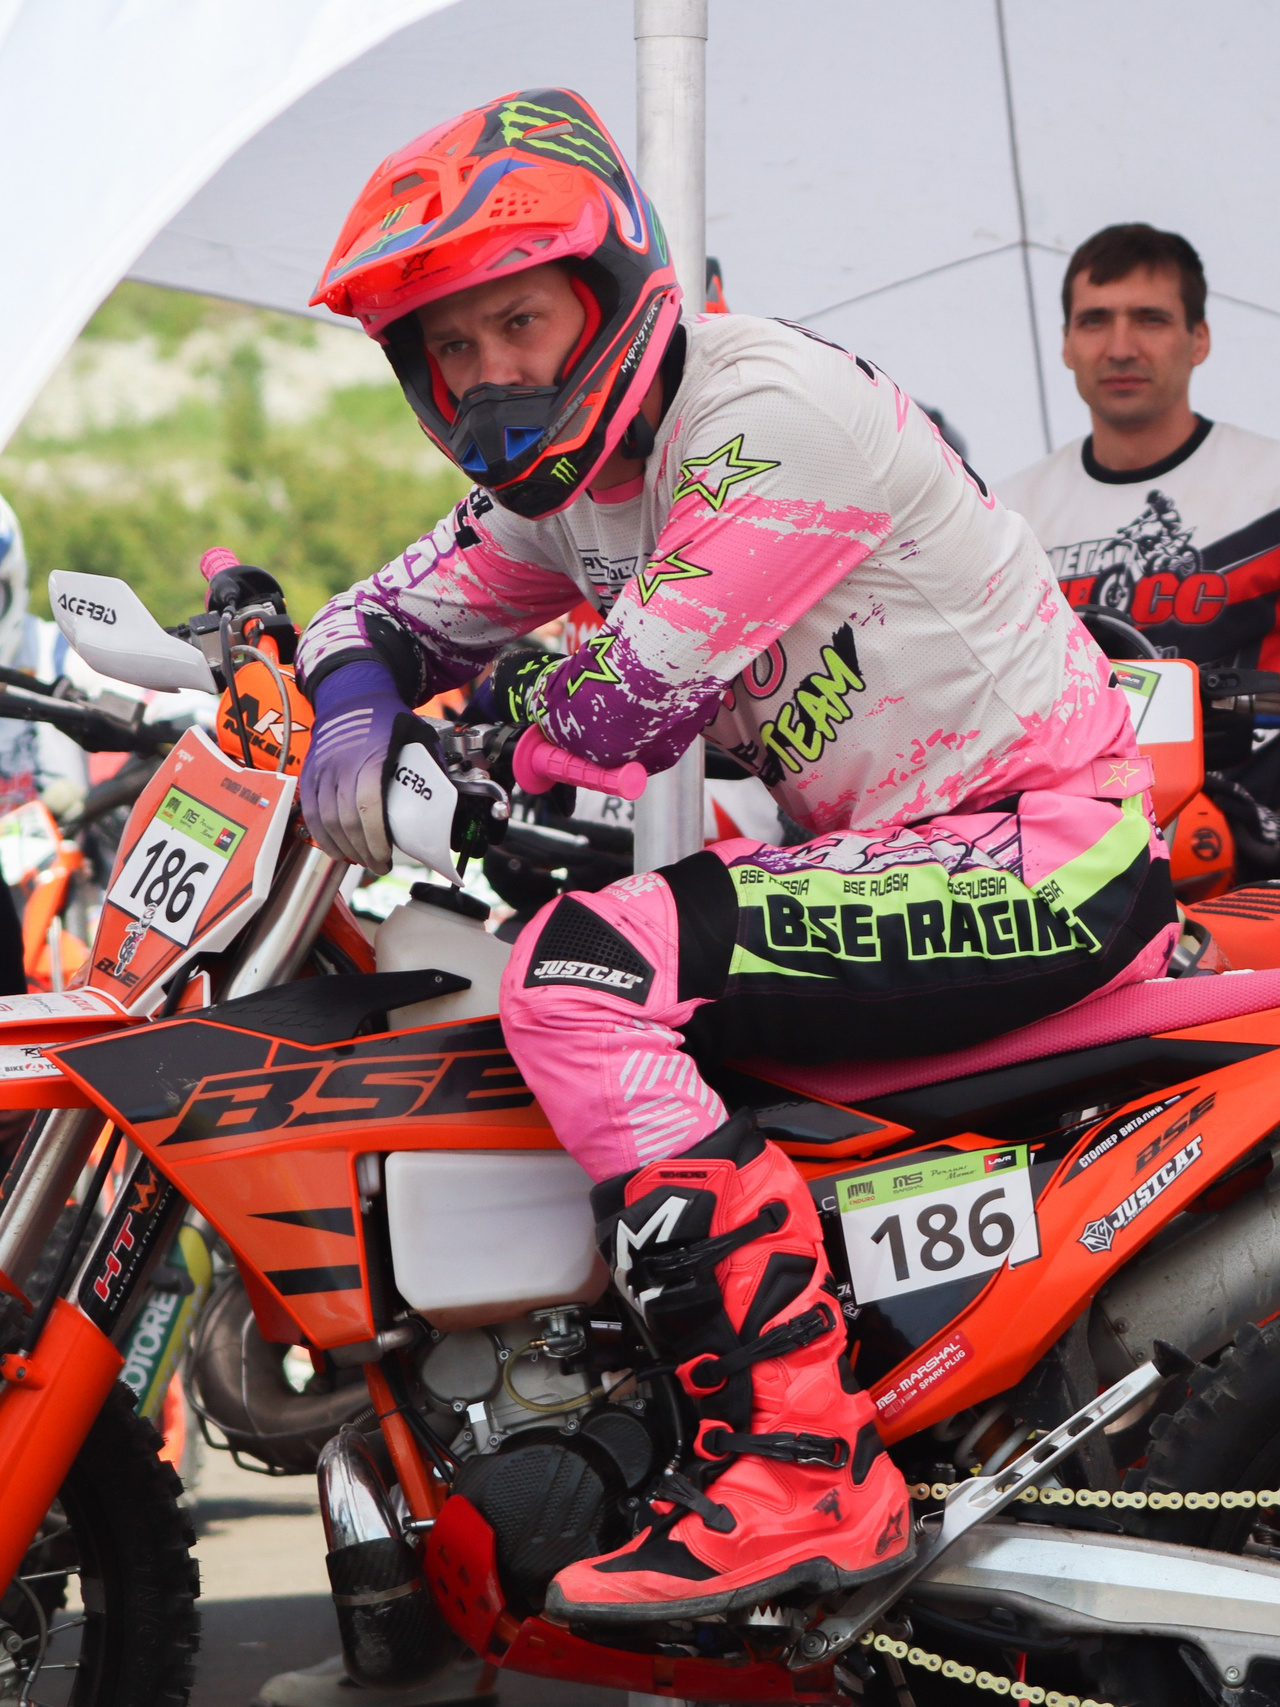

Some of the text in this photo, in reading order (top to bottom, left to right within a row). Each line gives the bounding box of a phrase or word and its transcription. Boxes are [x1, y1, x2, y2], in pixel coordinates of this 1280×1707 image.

[57, 593, 117, 625] ACERBIS
[759, 644, 867, 774] TEAM
[129, 839, 210, 924] 186
[740, 869, 765, 885] BSE
[843, 873, 909, 898] BSE RUSSIA
[766, 894, 881, 962] BSE
[533, 960, 644, 989] JUSTCAT
[5, 1064, 24, 1073] BIKE
[45, 1063, 58, 1071] YO
[1078, 1133, 1119, 1169] СТОЛПЕР
[1118, 1104, 1164, 1138] ВИТАЛИЙ
[1111, 1135, 1203, 1230] JUSTCAT
[870, 1187, 1015, 1282] 186
[875, 1342, 961, 1411] MS-MARSHAL
[918, 1349, 966, 1390] SPARK PLUG
